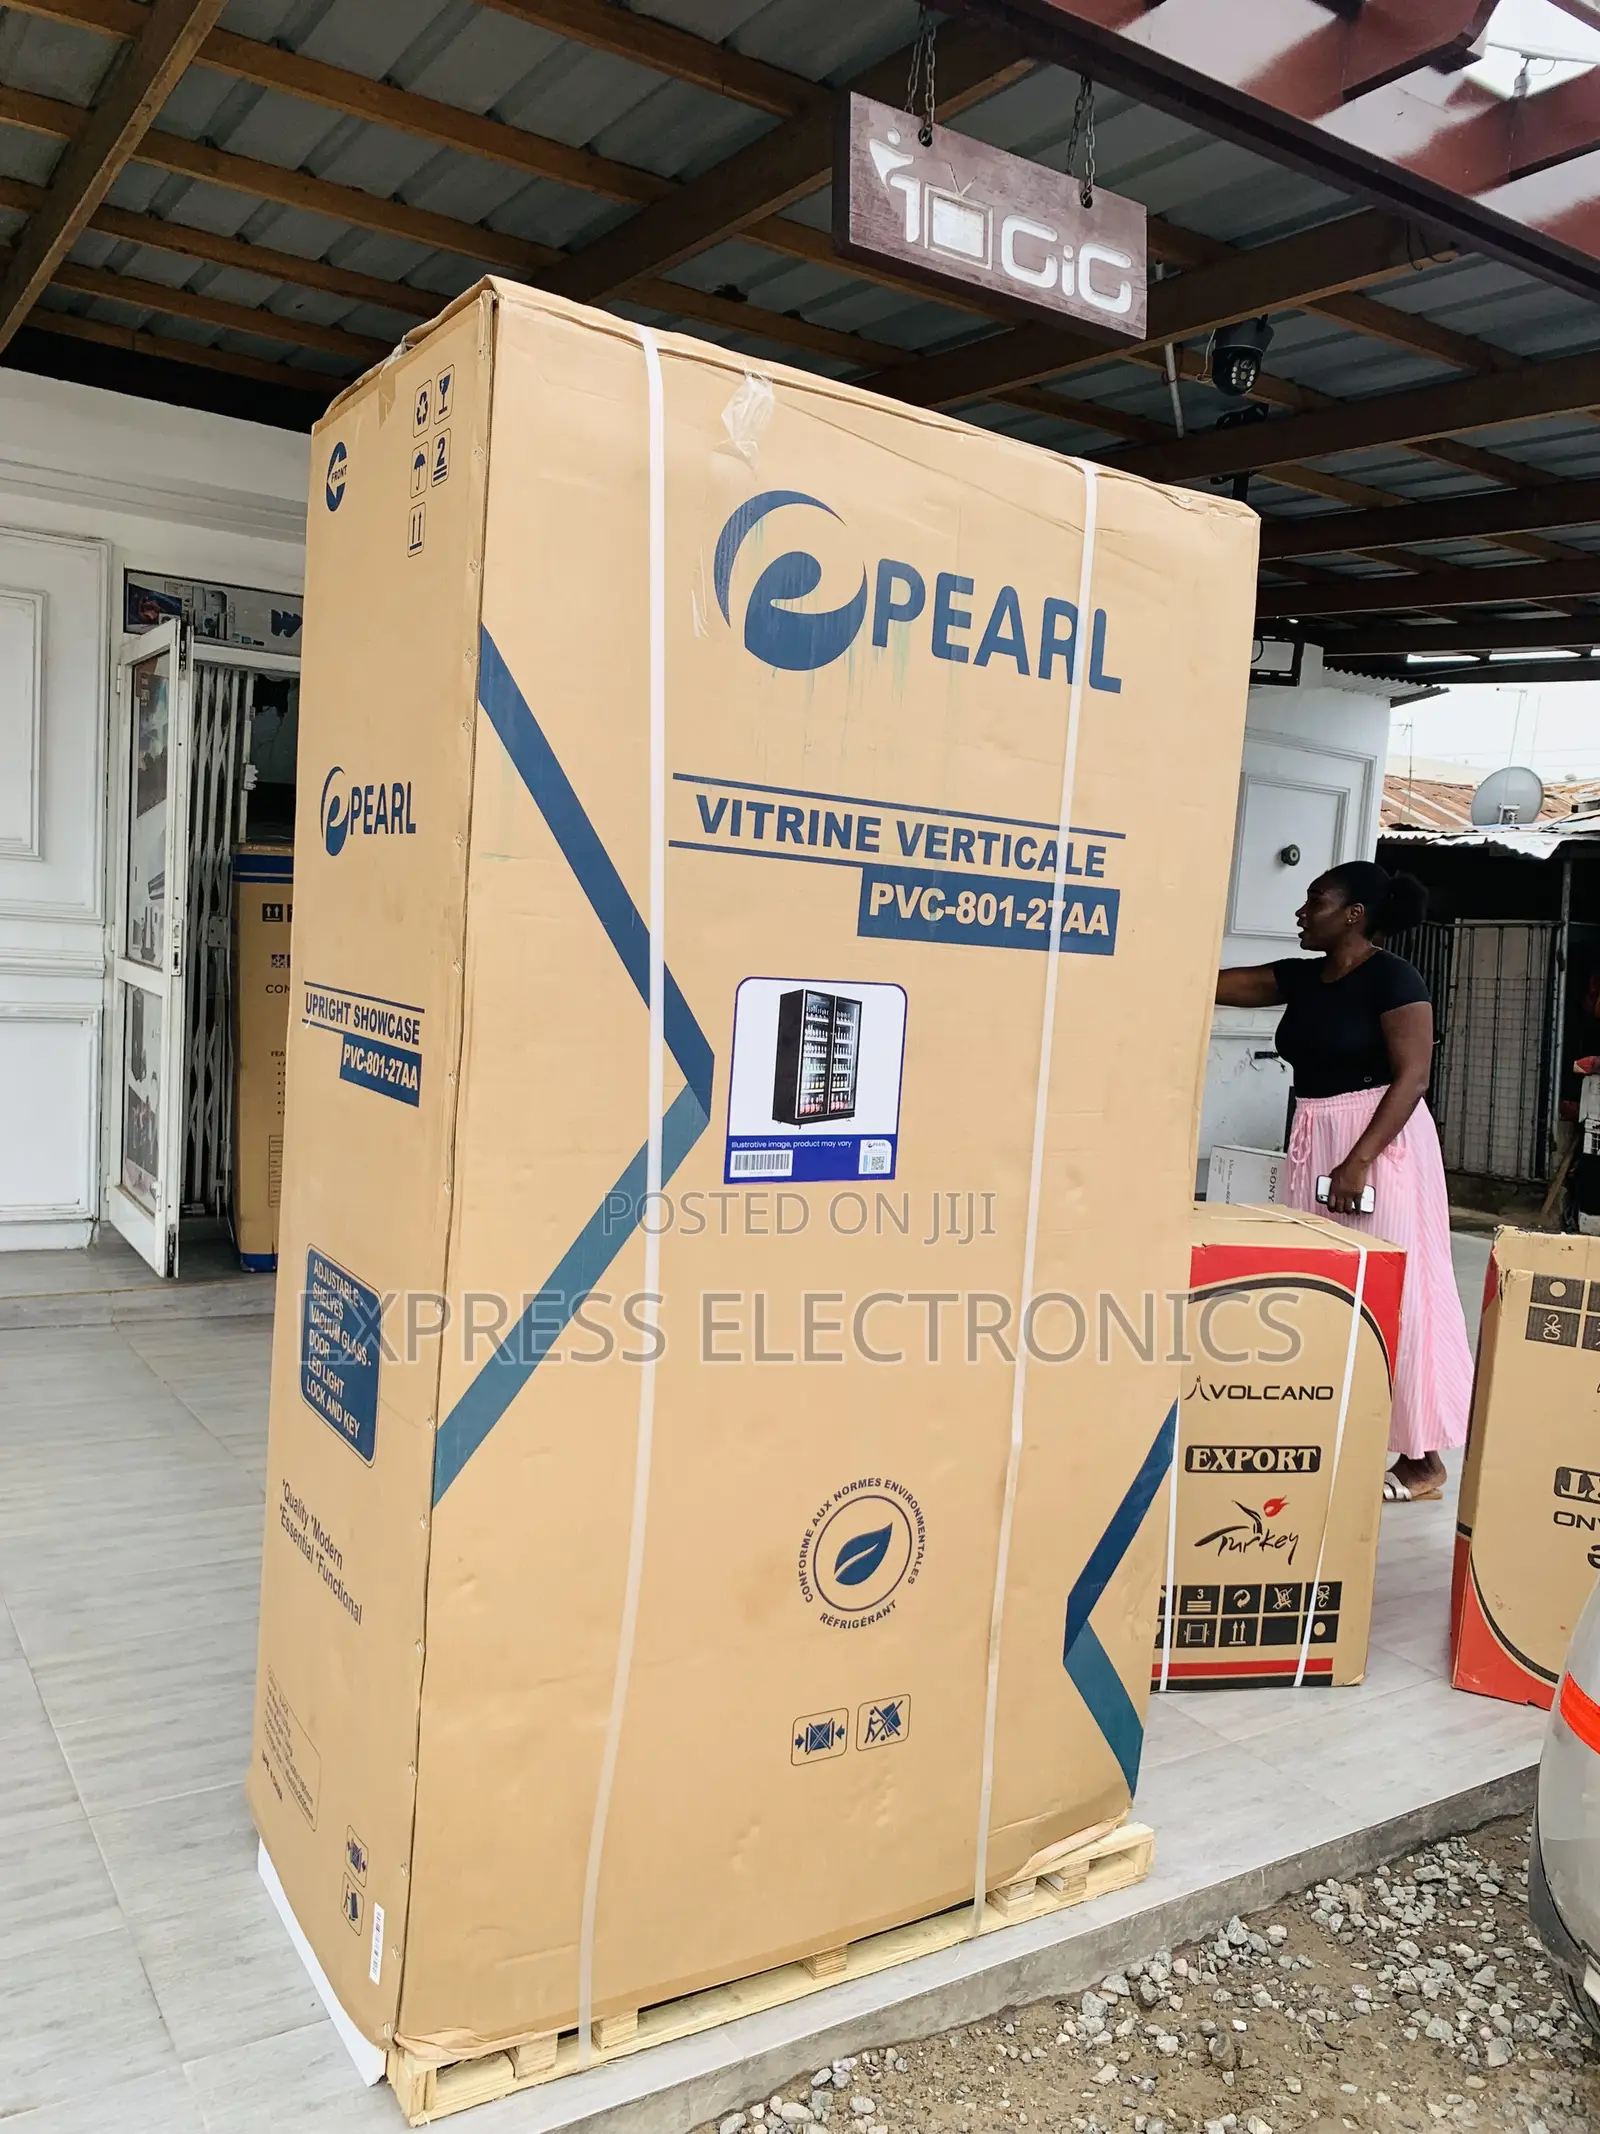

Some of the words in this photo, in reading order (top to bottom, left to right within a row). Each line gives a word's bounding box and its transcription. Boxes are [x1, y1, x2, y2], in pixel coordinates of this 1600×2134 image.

[331, 464, 348, 484] FRONT
[871, 557, 1123, 694] PEARL
[350, 781, 417, 836] PEARL
[695, 793, 882, 853] VITRINE
[896, 819, 1107, 879] VERTICALE
[305, 992, 351, 1026] UPRIGHT
[353, 1003, 420, 1046] SHOWCASE
[342, 1043, 419, 1092] PVC-801-27AA
[731, 1141, 767, 1149] Illustrative
[793, 1140, 820, 1149] product
[837, 1140, 853, 1149] vary
[1268, 1166, 1278, 1203] SONY
[312, 1281, 344, 1320] SHELVES
[310, 1304, 341, 1343] VACUUM
[309, 1328, 331, 1359] DOOR
[307, 1352, 322, 1375] LED
[322, 1371, 345, 1398] LIGHT
[1209, 1384, 1334, 1401] VOLCANO
[306, 1374, 326, 1407] LOCK
[326, 1397, 343, 1424] AND
[343, 1409, 361, 1439] KEY
[1190, 1448, 1318, 1472] EXPORT
[798, 1528, 815, 1604] CONFORME
[811, 1500, 833, 1527] AUX
[833, 1477, 882, 1502] NORMES
[884, 1479, 926, 1585] ENVIRONMENTALES
[819, 1599, 897, 1630] RÉFRIGÉRANT
